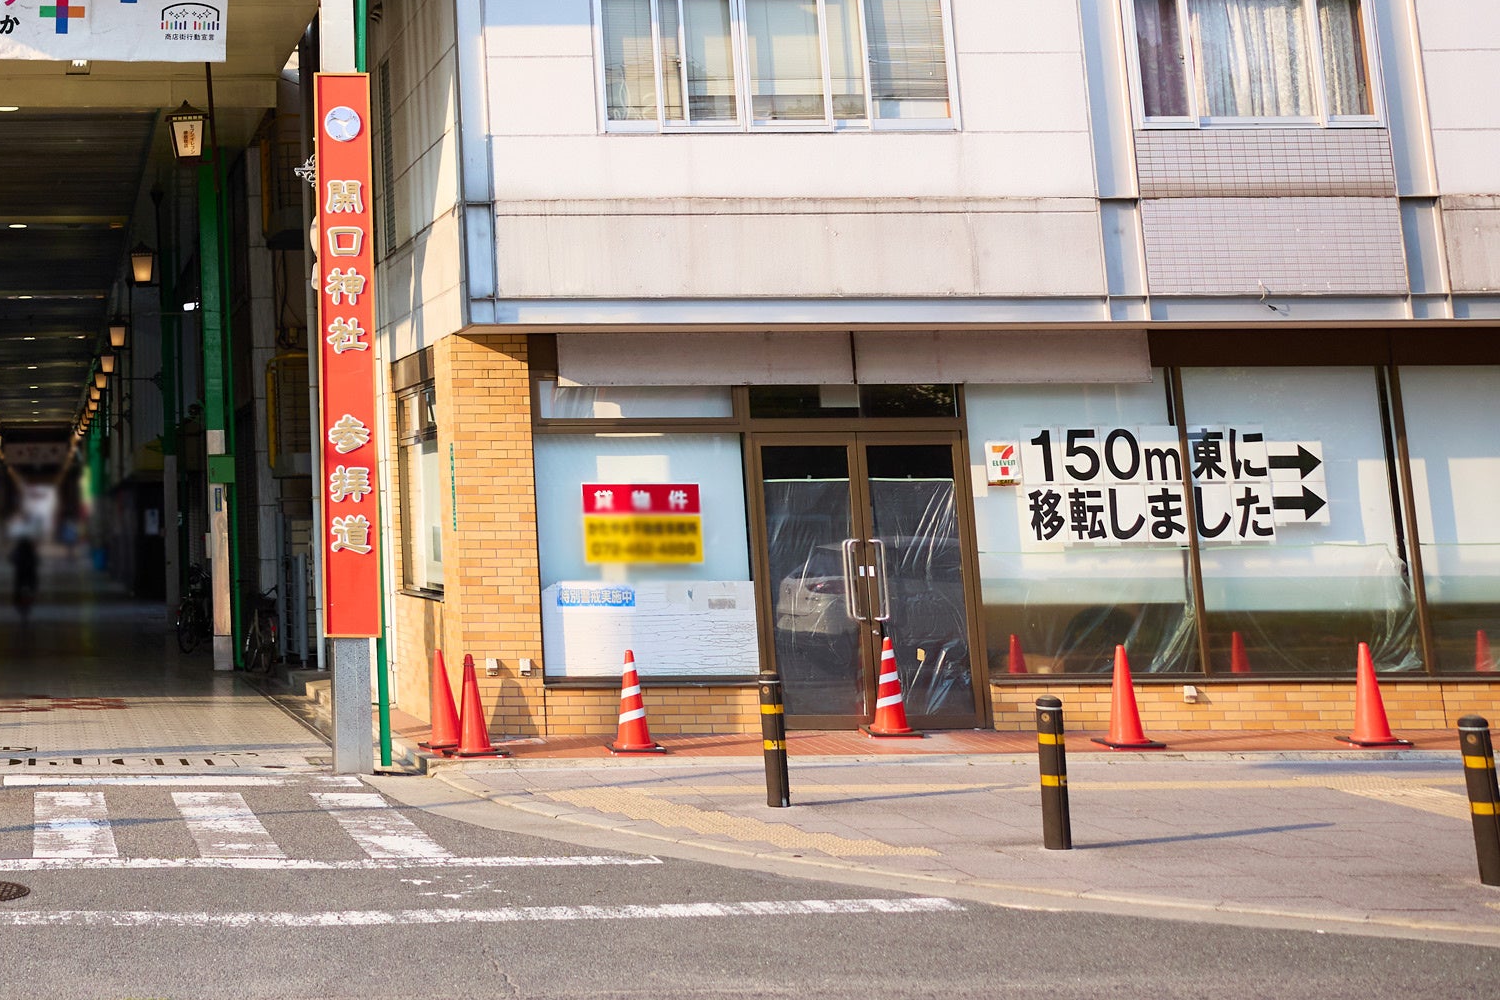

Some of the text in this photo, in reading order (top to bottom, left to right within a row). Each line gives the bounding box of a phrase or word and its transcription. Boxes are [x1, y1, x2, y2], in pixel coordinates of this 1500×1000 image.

[325, 180, 371, 554] 開口神社 参拝道
[1028, 485, 1275, 541] 移転しました
